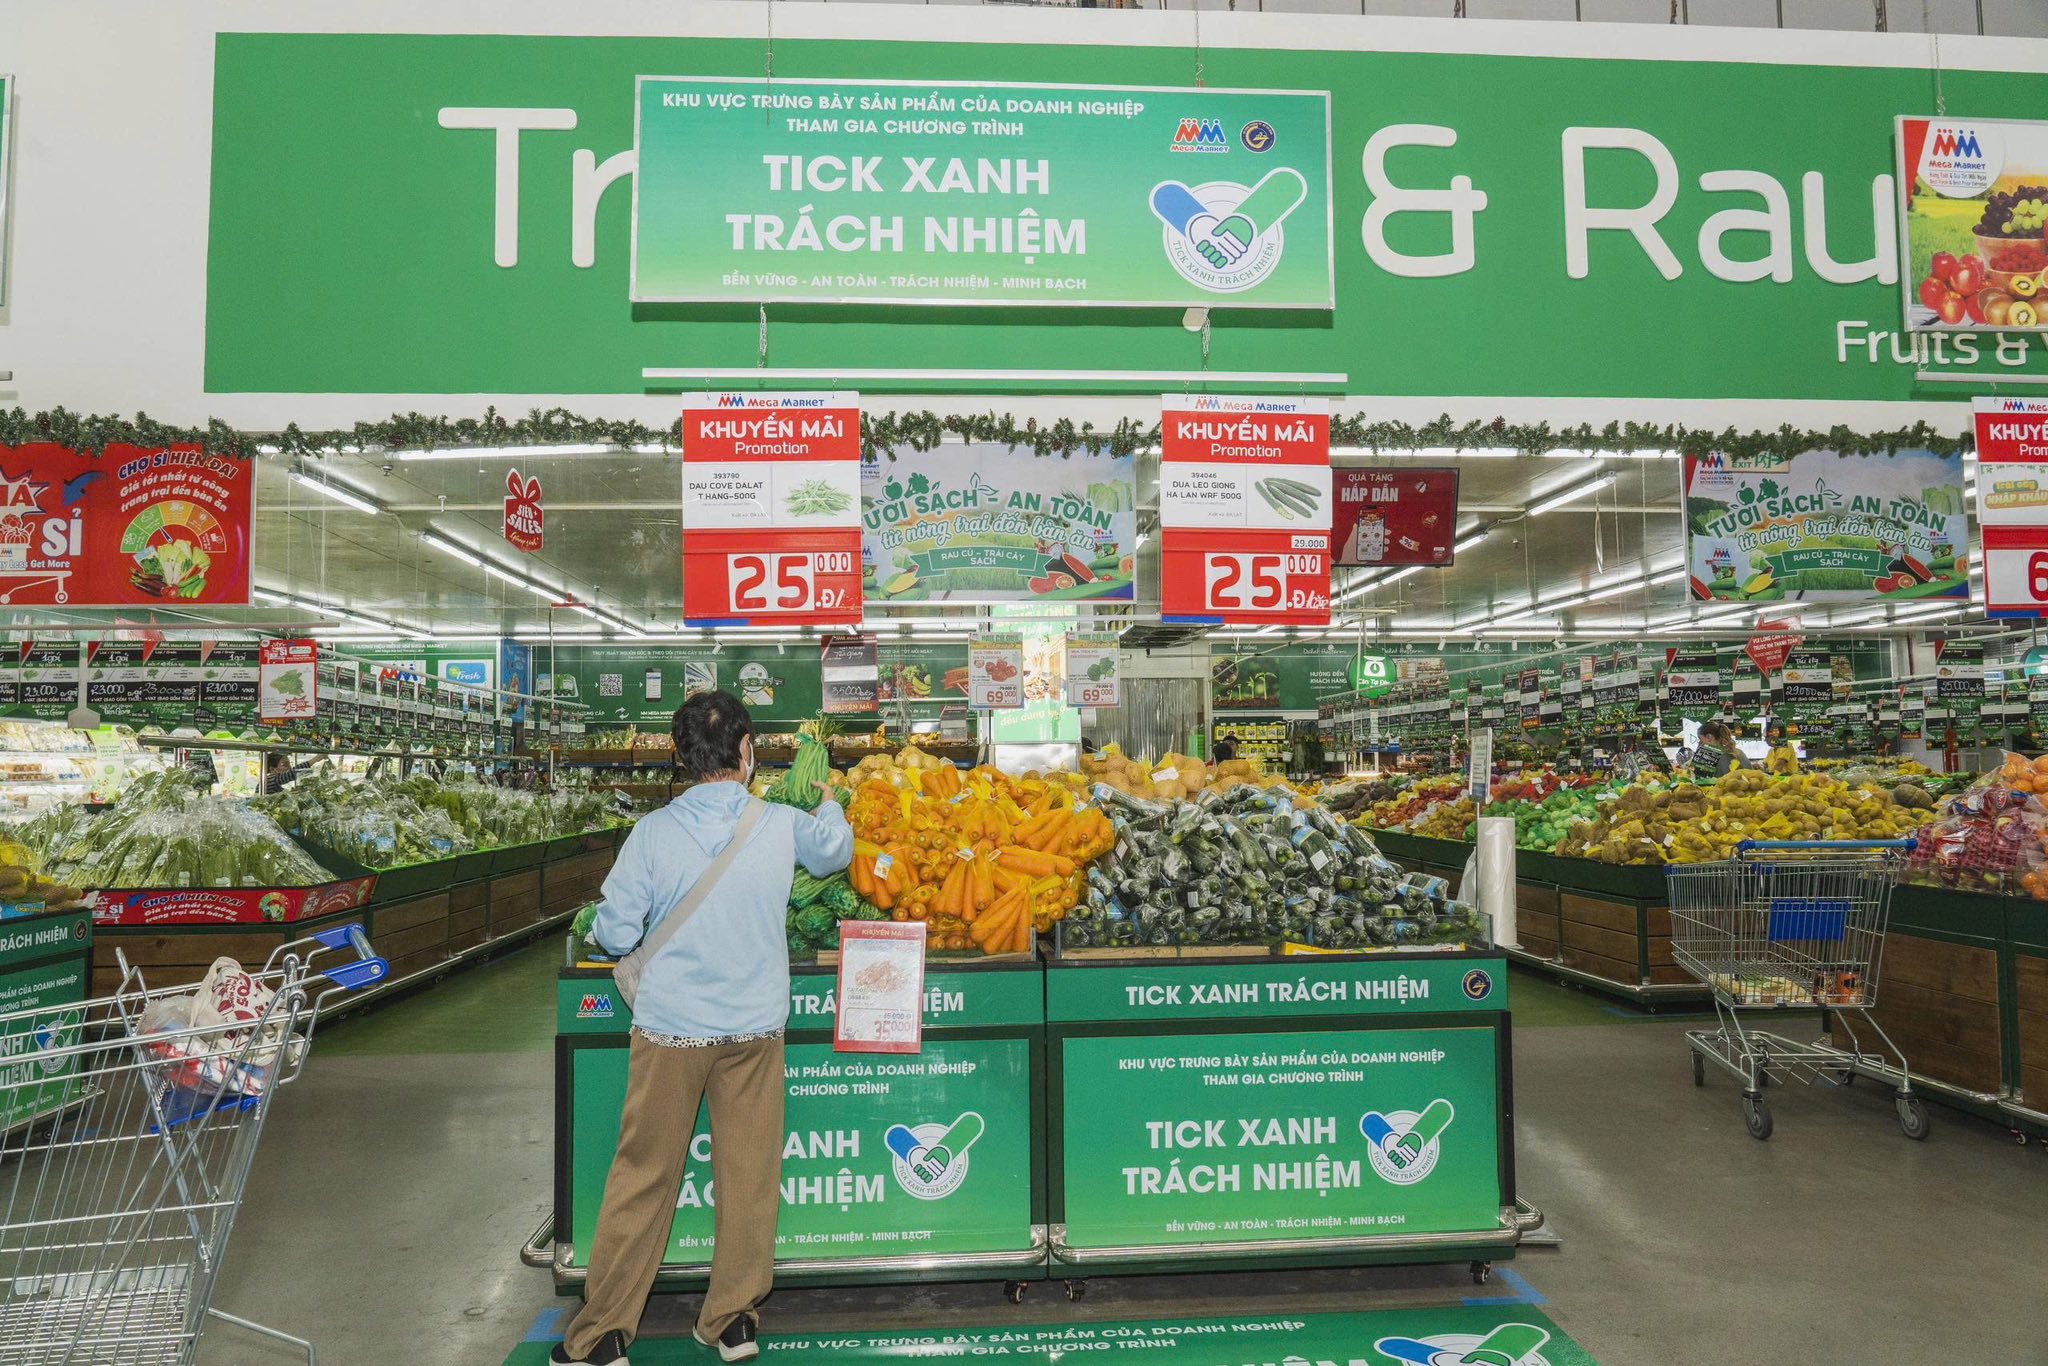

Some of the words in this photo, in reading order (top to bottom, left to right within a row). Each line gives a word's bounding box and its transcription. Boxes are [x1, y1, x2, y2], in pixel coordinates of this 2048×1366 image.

[663, 93, 700, 107] KHU
[706, 93, 747, 112] VỰC
[751, 93, 813, 109] TRƯNG
[818, 92, 855, 110] BÀY
[859, 92, 897, 110] SẢN
[902, 90, 955, 112] PHẨM
[960, 94, 1002, 113] CỦA
[1006, 99, 1074, 114] DOANH
[1077, 98, 1145, 118] NGHIỆP
[787, 118, 839, 133] THAM
[844, 118, 879, 133] GIA
[883, 118, 968, 135] CHƯƠNG
[971, 118, 1025, 137] TRÌNH
[763, 154, 885, 193] TICK
[900, 156, 1050, 196] XANH
[1929, 160, 1952, 168] Mega
[1953, 161, 1986, 169] Market
[1561, 126, 1898, 285] Rau
[726, 203, 904, 253] TRÁCH
[923, 207, 1087, 265] NHIỆM
[1172, 239, 1187, 264] TICK
[1187, 261, 1215, 283] XANH
[1218, 269, 1253, 285] TRÁCH
[1253, 241, 1276, 273] NHIỆM
[722, 269, 752, 287] BỀN
[754, 272, 799, 288] VỮNG
[811, 276, 833, 289] AN
[836, 273, 878, 289] TOÀN
[889, 274, 940, 289] TRÁCH
[943, 274, 991, 292] NHIỆM
[1002, 277, 1042, 289] MINH
[1045, 278, 1087, 293] BẠCH
[1835, 319, 1980, 367] Fruits
[700, 412, 794, 439] KHUYẾN
[801, 414, 844, 439] MÃI
[1178, 416, 1268, 442] KHUYẾN
[1275, 420, 1315, 443] MÃI
[735, 441, 809, 455] Promotion
[1211, 443, 1282, 457] Promotion
[118, 455, 151, 480] CHỢ
[152, 448, 170, 468] SỈ
[713, 472, 740, 480] 393790
[120, 480, 141, 498] Giá
[142, 472, 158, 486] tốt
[160, 469, 187, 483] nhất
[202, 480, 230, 499] nông
[689, 482, 708, 490] DAU
[709, 482, 733, 490] COVE
[735, 481, 764, 489] DALAT
[1192, 481, 1209, 489] LEO
[1211, 482, 1236, 490] GIONG
[1348, 472, 1368, 483] QUÀ
[1369, 472, 1394, 486] TẶNG
[121, 492, 149, 513] trang
[151, 485, 170, 499] trại
[172, 483, 191, 496] đến
[193, 489, 213, 503] bàn
[213, 498, 229, 513] ăn
[1220, 492, 1242, 500] 500G
[1340, 483, 1369, 503] HẤP
[1371, 483, 1399, 503] DẪN
[507, 513, 543, 534] SALES
[863, 504, 909, 532] ƯƠI
[916, 488, 979, 516] SẠCH
[1007, 490, 1042, 513] AN
[1049, 496, 1113, 532] TOÀN
[1707, 505, 1761, 539] TƯƠI
[1768, 495, 1824, 521] SẠCH
[1850, 494, 1882, 516] AN
[1887, 499, 1948, 534] TOÀN
[41, 507, 83, 558] SỈ
[880, 527, 905, 551] từ
[906, 517, 951, 546] nông
[953, 511, 991, 538] trại
[993, 510, 1029, 534] đến
[1030, 517, 1068, 542] bàn
[1068, 528, 1096, 551] ăn
[1294, 539, 1325, 548] 29.000
[1737, 530, 1758, 553] từ
[1759, 521, 1802, 550] nông
[1802, 518, 1836, 542] trại
[1838, 515, 1872, 538] đến
[1873, 518, 1908, 546] bàn
[1907, 529, 1933, 552] ăn
[48, 560, 70, 568] More
[733, 555, 810, 610] 25
[816, 553, 849, 572] 000
[1211, 556, 1282, 608] 25
[1287, 555, 1318, 573] 000
[986, 691, 1004, 703] 69
[1082, 689, 1100, 702] 69
[0, 932, 34, 952] RÁCH
[35, 925, 68, 944] NHIỆM
[792, 989, 835, 1015] TRÁ
[1125, 985, 1182, 1006] TICK
[1188, 982, 1258, 1005] XANH
[1265, 976, 1347, 1003] TRÁCH
[1354, 974, 1430, 1005] NHIỆM
[803, 1060, 842, 1078] PHẨM
[845, 1061, 874, 1077] CỦA
[877, 1063, 926, 1076] DOANH
[928, 1060, 977, 1076] NGHIỆP
[1119, 1059, 1145, 1071] KHU
[1148, 1056, 1177, 1073] VỰC
[1178, 1055, 1221, 1069] TRƯNG
[1224, 1053, 1250, 1068] BÀY
[1252, 1051, 1278, 1067] SẢN
[1280, 1048, 1319, 1067] PHẨM
[1321, 1049, 1349, 1065] CỦA
[1351, 1052, 1397, 1064] DOANH
[1399, 1048, 1446, 1065] NGHIỆP
[1203, 1074, 1239, 1086] THAM
[1242, 1073, 1266, 1085] GIA
[1268, 1070, 1326, 1085] CHƯƠNG
[1328, 1068, 1364, 1083] TRÌNH
[782, 1129, 860, 1160] ANH
[1146, 1119, 1227, 1149] TICK
[1238, 1116, 1337, 1147] XANH
[1122, 1157, 1241, 1196] TRÁCH
[1253, 1153, 1361, 1198] NHIỆM
[779, 1167, 885, 1213] NHIỆM
